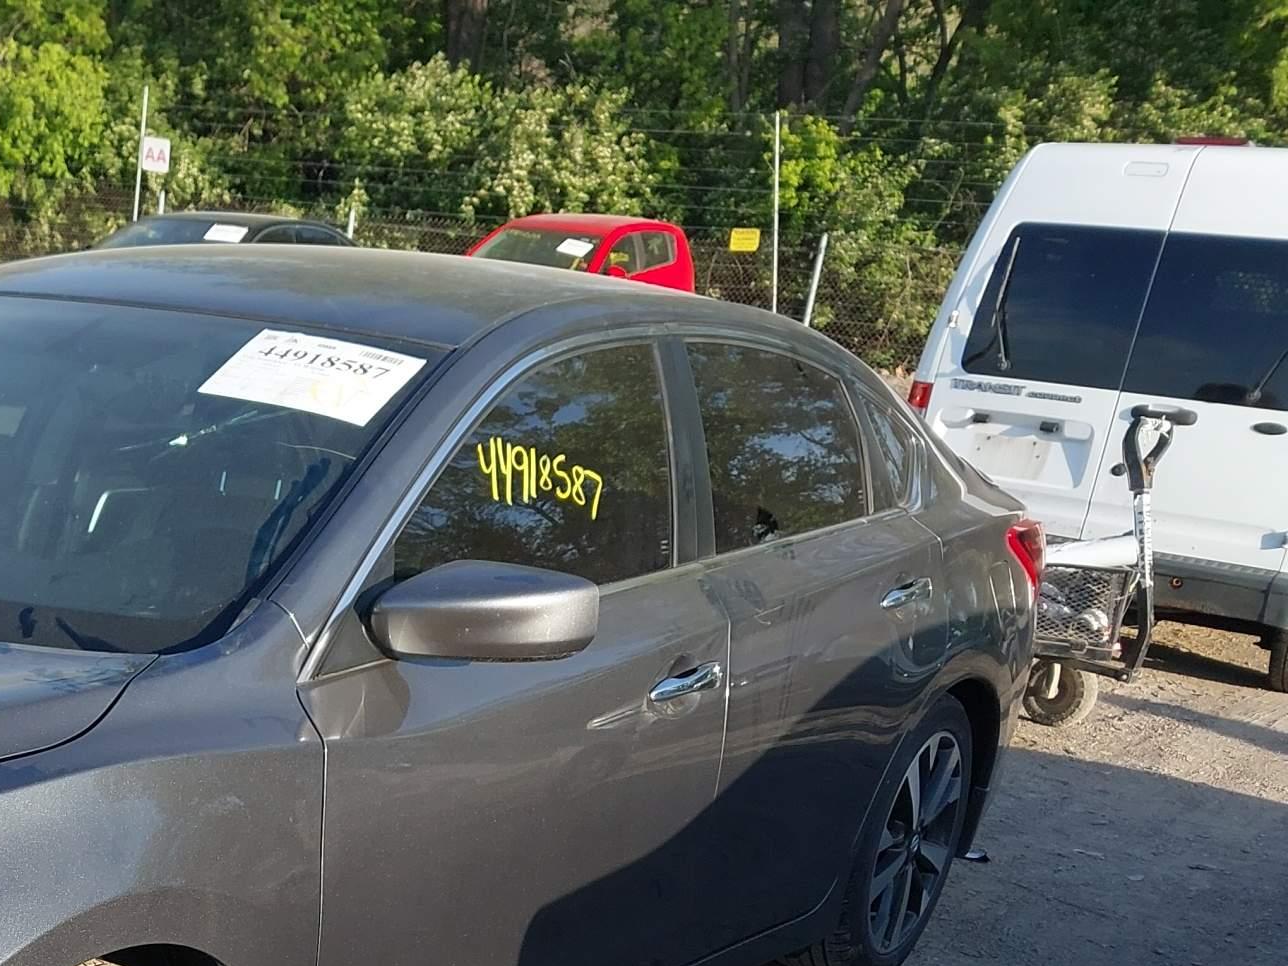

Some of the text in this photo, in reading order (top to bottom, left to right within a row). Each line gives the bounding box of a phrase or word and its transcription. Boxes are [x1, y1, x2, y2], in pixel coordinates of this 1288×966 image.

[145, 147, 167, 164] AA
[258, 345, 392, 379] 44918587
[476, 435, 603, 521] 44918587
